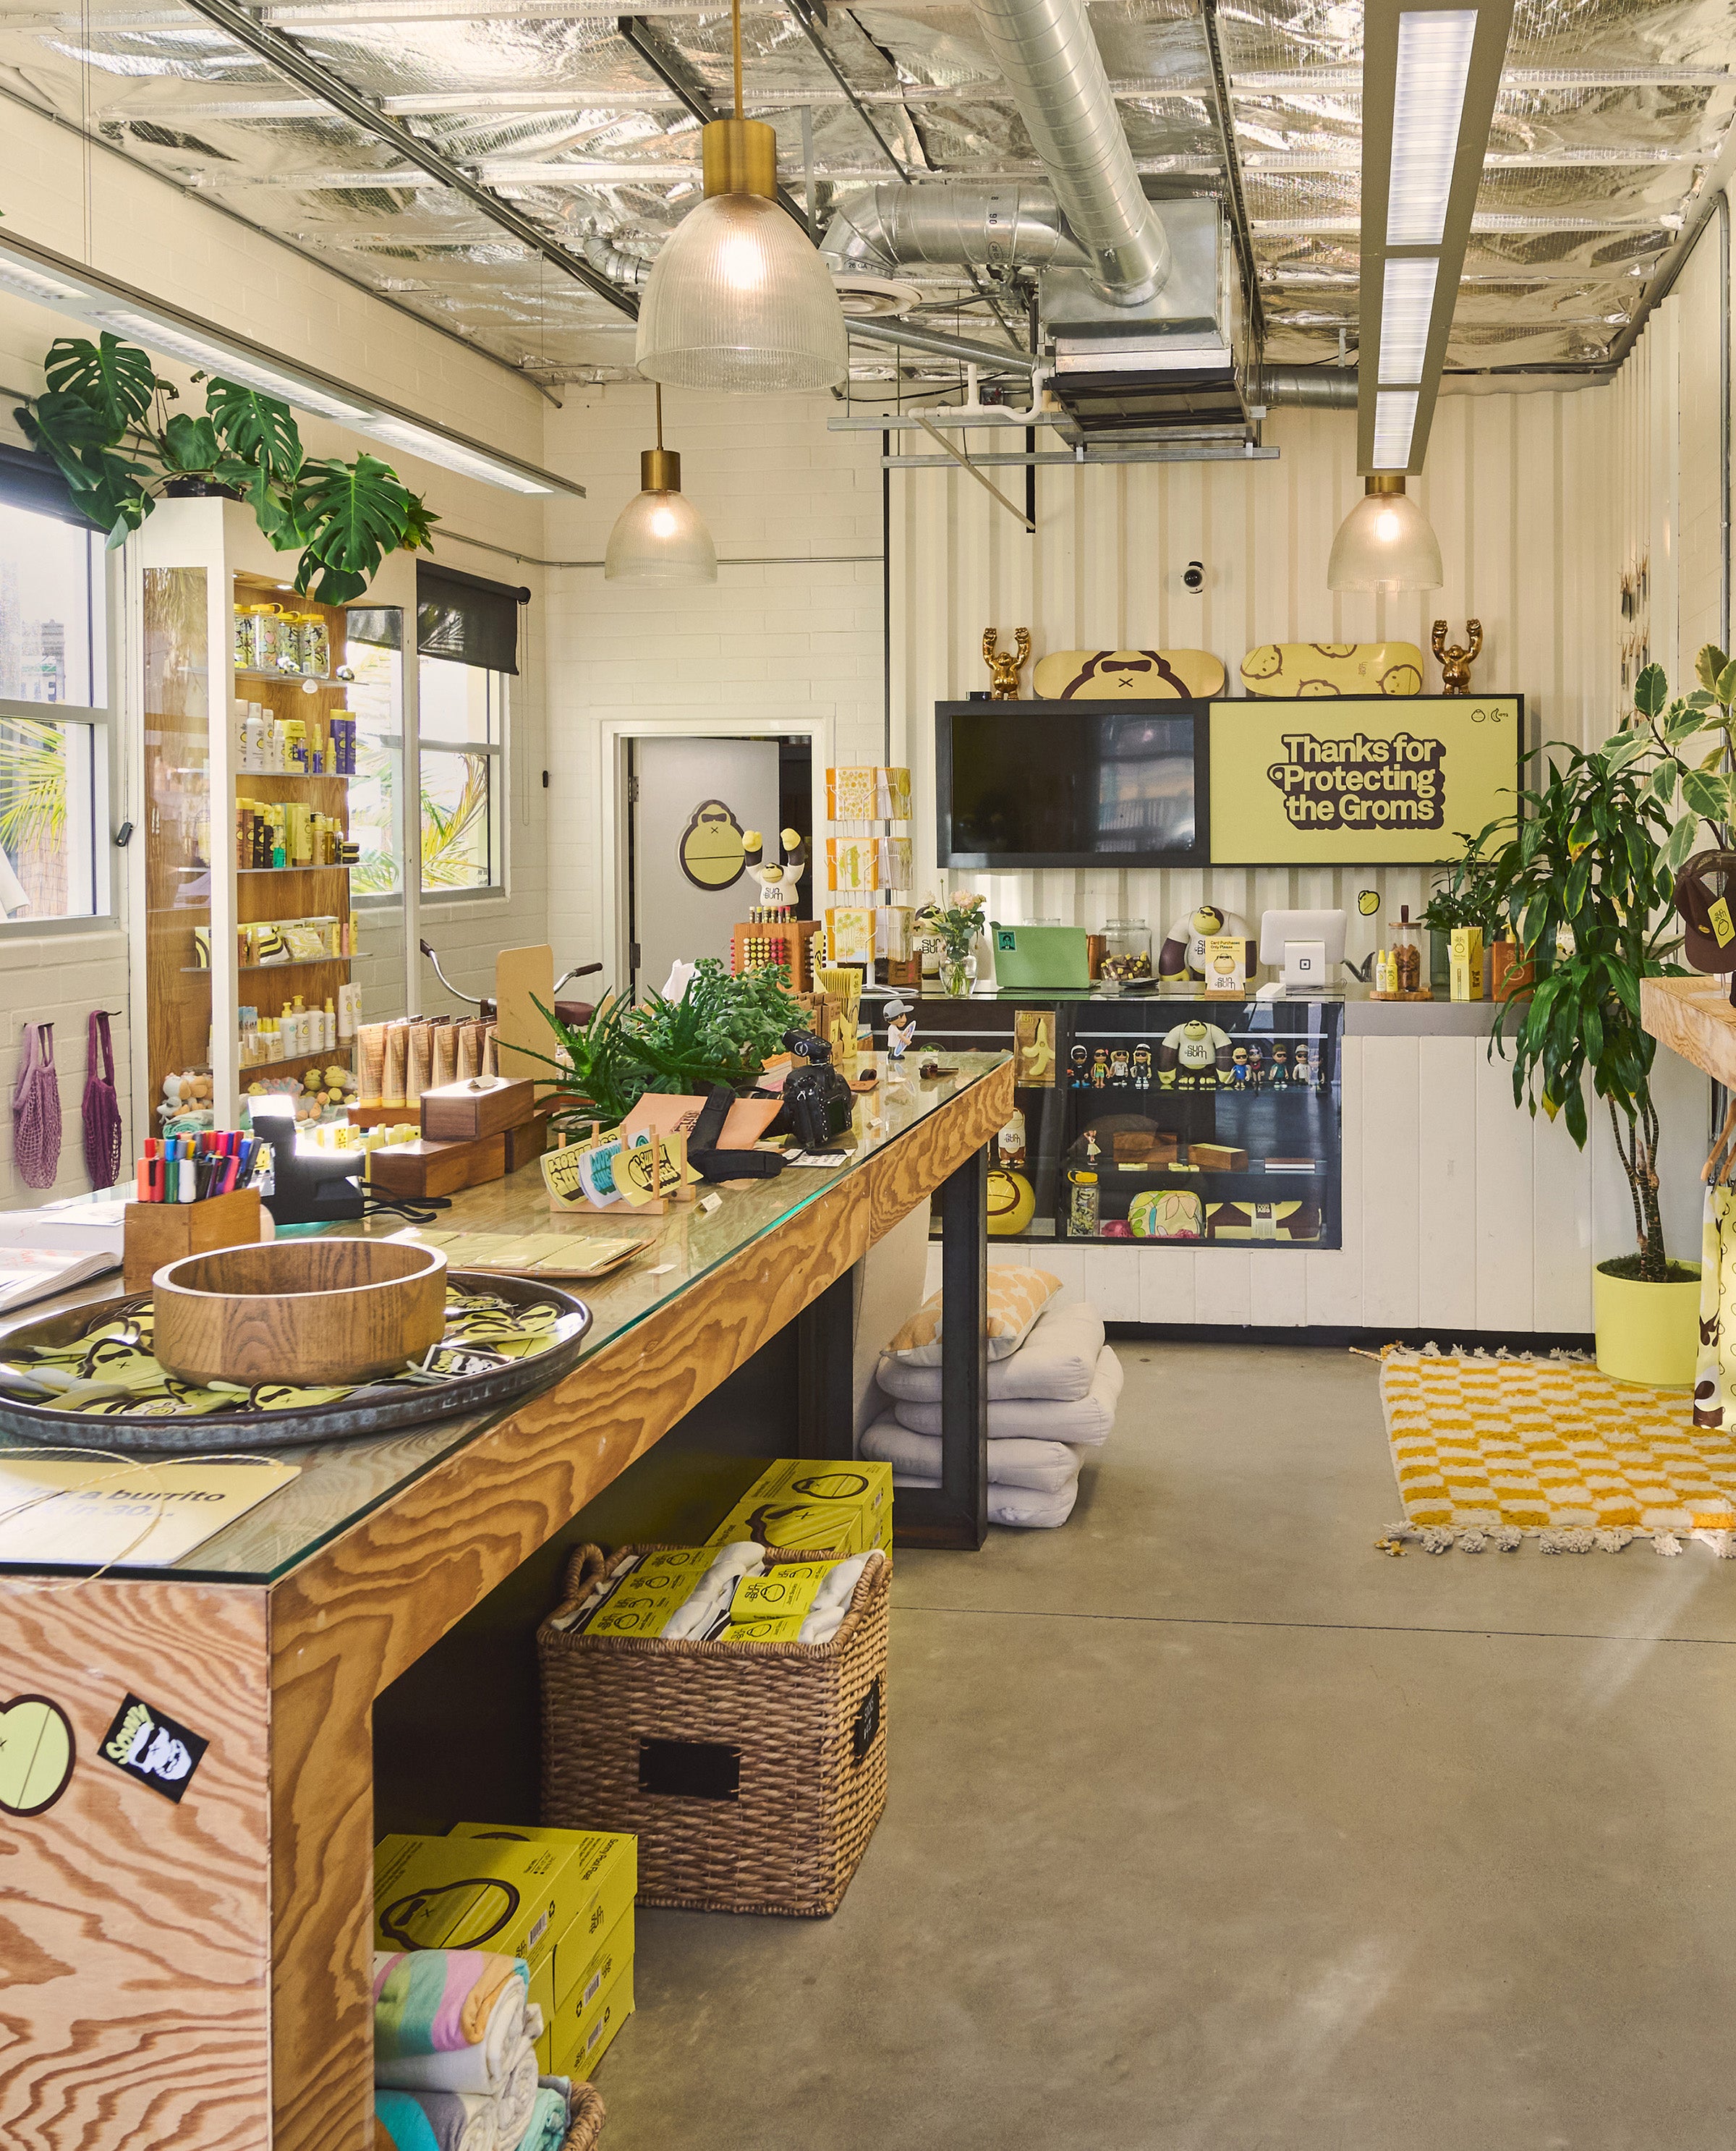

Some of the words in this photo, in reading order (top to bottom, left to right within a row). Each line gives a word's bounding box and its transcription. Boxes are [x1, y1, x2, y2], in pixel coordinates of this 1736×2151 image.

[1283, 735, 1390, 763] Thanks
[1392, 734, 1437, 762] for
[1269, 763, 1436, 798] Protecting
[1286, 794, 1335, 820] the
[1338, 793, 1435, 820] Groms
[77, 1490, 103, 1500] a
[106, 1489, 226, 1502] burrito
